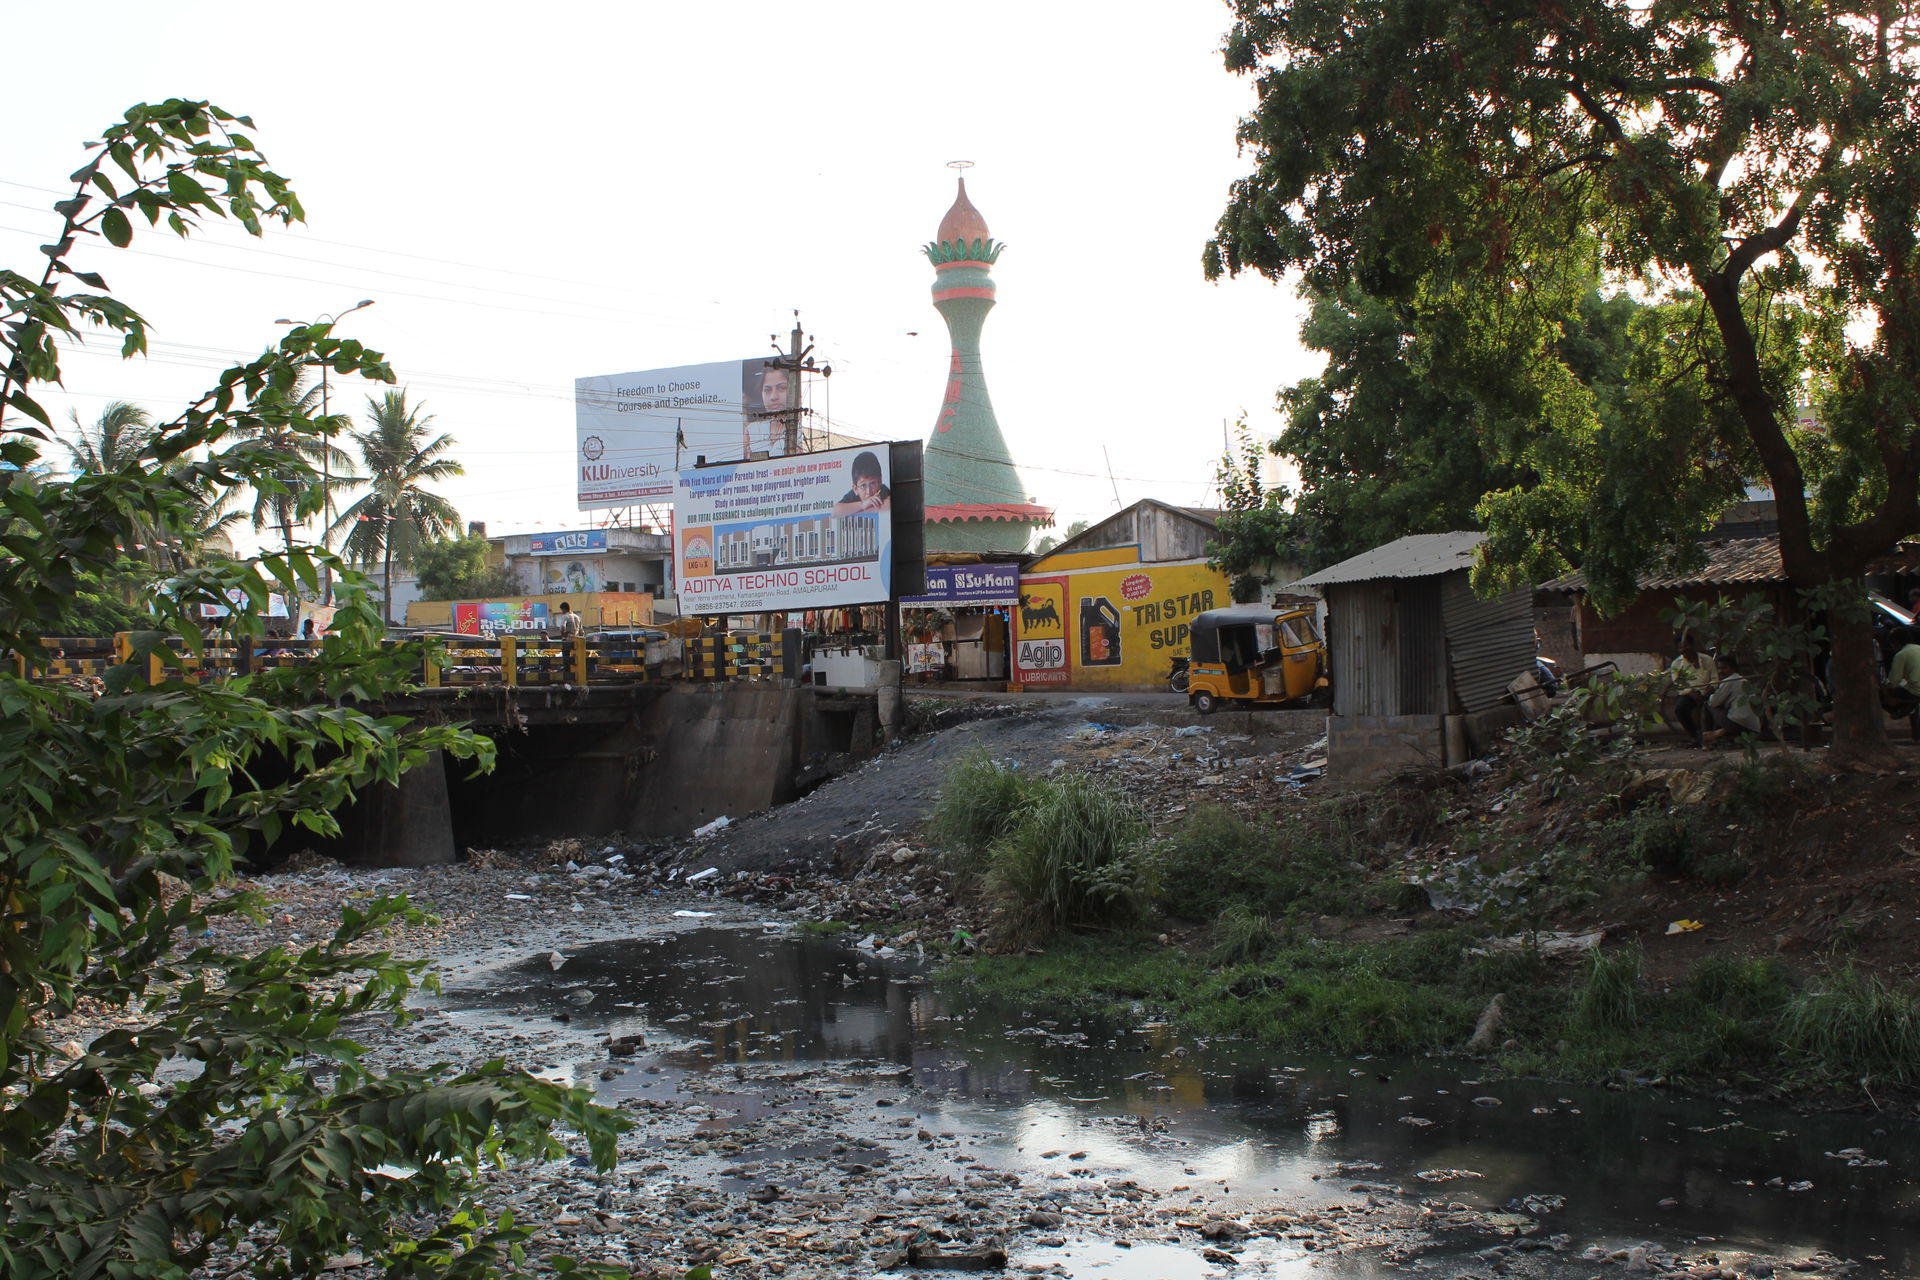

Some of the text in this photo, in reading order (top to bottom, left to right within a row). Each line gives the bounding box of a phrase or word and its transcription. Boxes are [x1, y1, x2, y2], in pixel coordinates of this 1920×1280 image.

[617, 380, 701, 398] Freedom to Choose
[617, 392, 727, 412] Courses and Specialize...
[702, 476, 716, 486] Years
[716, 475, 722, 485] of
[734, 470, 755, 481] Parental
[756, 468, 769, 480] Trust
[773, 469, 780, 477] we
[781, 466, 795, 476] enter
[796, 464, 806, 473] into
[807, 463, 817, 472] new
[818, 460, 842, 472] premises
[689, 490, 706, 500] Larger
[722, 486, 733, 496] airy
[734, 484, 750, 494] rooms,
[751, 483, 763, 492] huge
[764, 478, 793, 492] playground,
[793, 476, 815, 487] brighter
[714, 491, 804, 509] Study in abounding nature's greenery
[687, 499, 834, 524] OUR TOTAL ASSURANCE to challenging growth of your children
[683, 565, 871, 594] ADITYA TECHNO SCHOOL
[1150, 622, 1191, 650] SUP
[1019, 641, 1062, 668] Agip
[1019, 671, 1067, 682] LUBRICANTS
